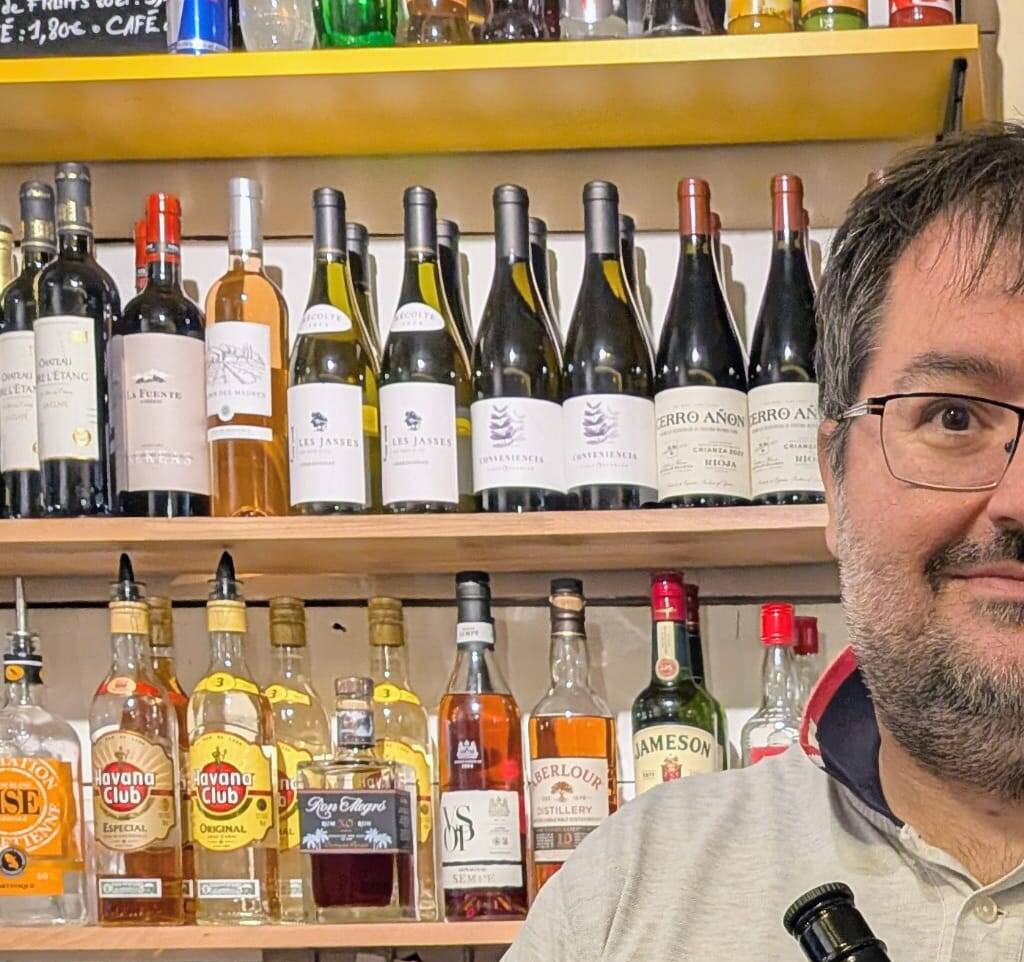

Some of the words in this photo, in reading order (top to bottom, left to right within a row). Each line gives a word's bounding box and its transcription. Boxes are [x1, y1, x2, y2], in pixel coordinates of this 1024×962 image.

[105, 9, 161, 36] CAFÉ
[138, 388, 182, 400] FUENTE
[793, 404, 819, 421] AÑ
[298, 439, 315, 447] LES
[320, 437, 359, 448] JASSES
[392, 438, 409, 446] LES
[414, 436, 452, 447] JASSES
[704, 458, 737, 469] RIOJA
[216, 677, 225, 687] 3
[270, 689, 278, 698] 3
[383, 688, 391, 698] 3
[634, 733, 712, 760] JAMESON
[95, 769, 156, 787] Havana
[194, 769, 254, 787] Havana
[103, 785, 142, 805] Club
[201, 785, 240, 805] Club
[305, 796, 338, 820] Ron
[102, 822, 148, 834] ESPECIAL
[199, 822, 248, 834] ORIGINAL
